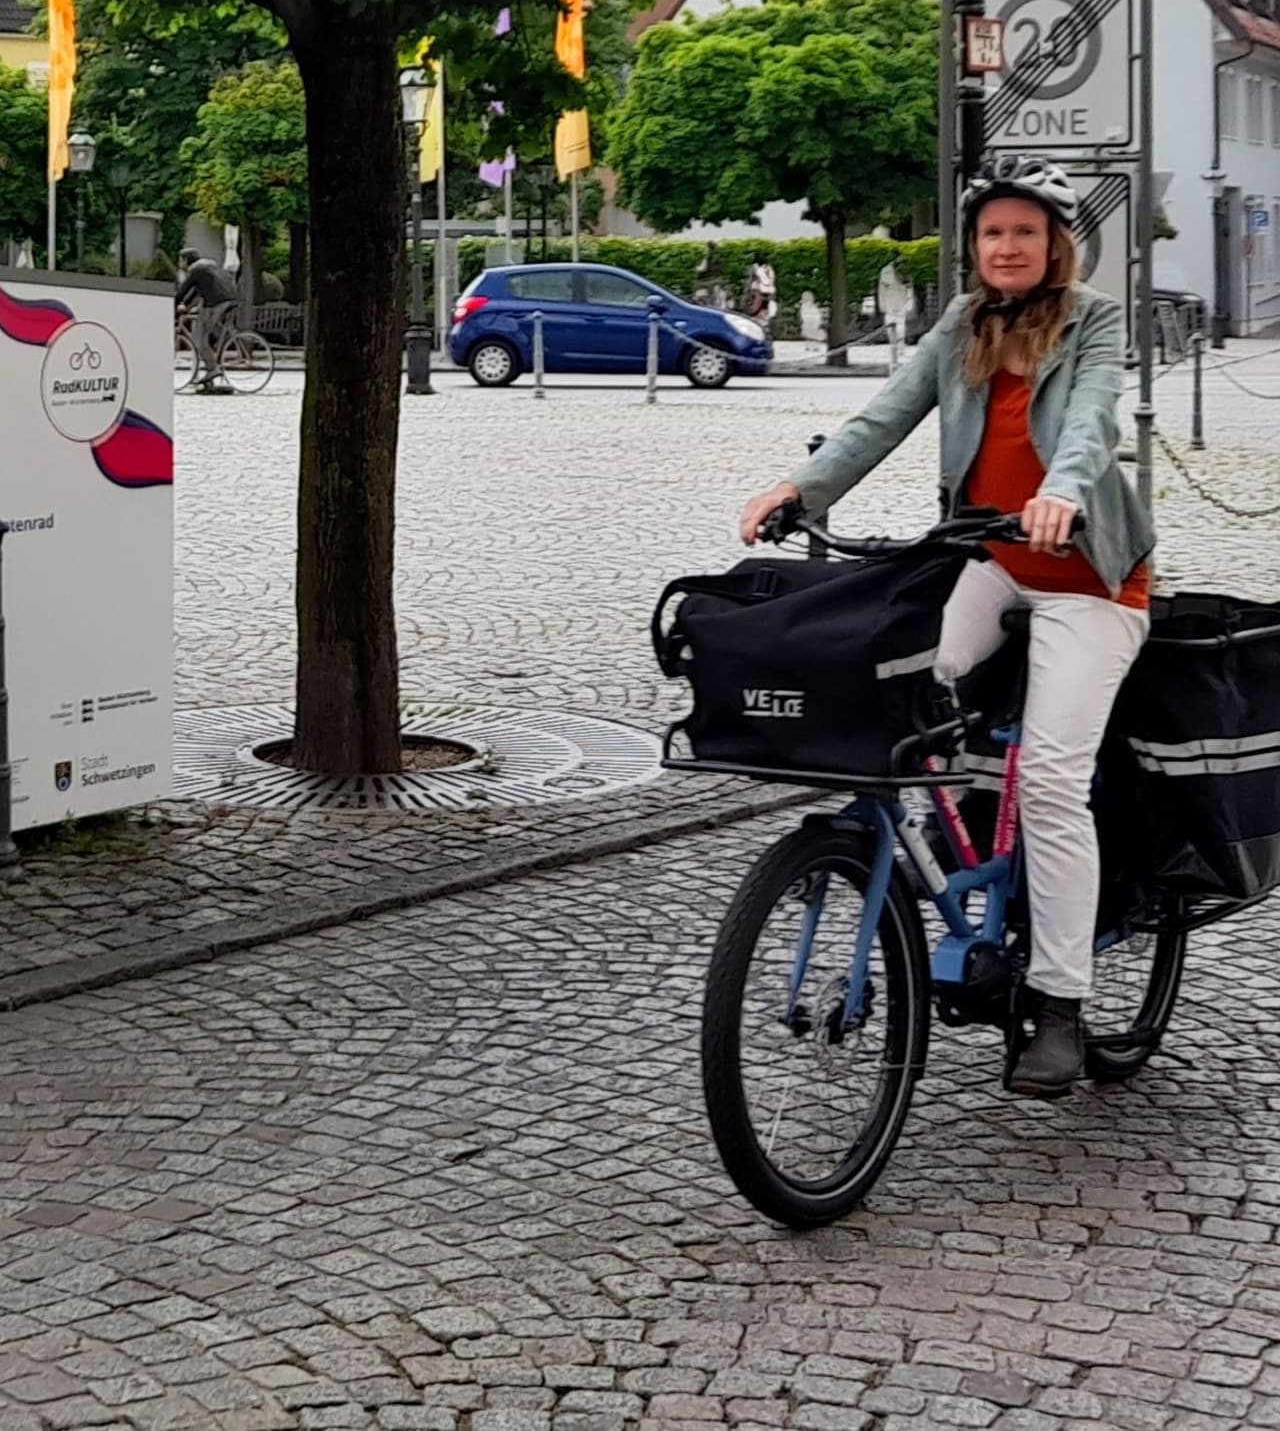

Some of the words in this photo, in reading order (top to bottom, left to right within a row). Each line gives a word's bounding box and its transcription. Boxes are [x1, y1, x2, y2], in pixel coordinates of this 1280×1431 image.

[1003, 109, 1089, 137] ZONE
[52, 376, 120, 394] RadKULTUR
[81, 762, 157, 787] Schwetzingen
